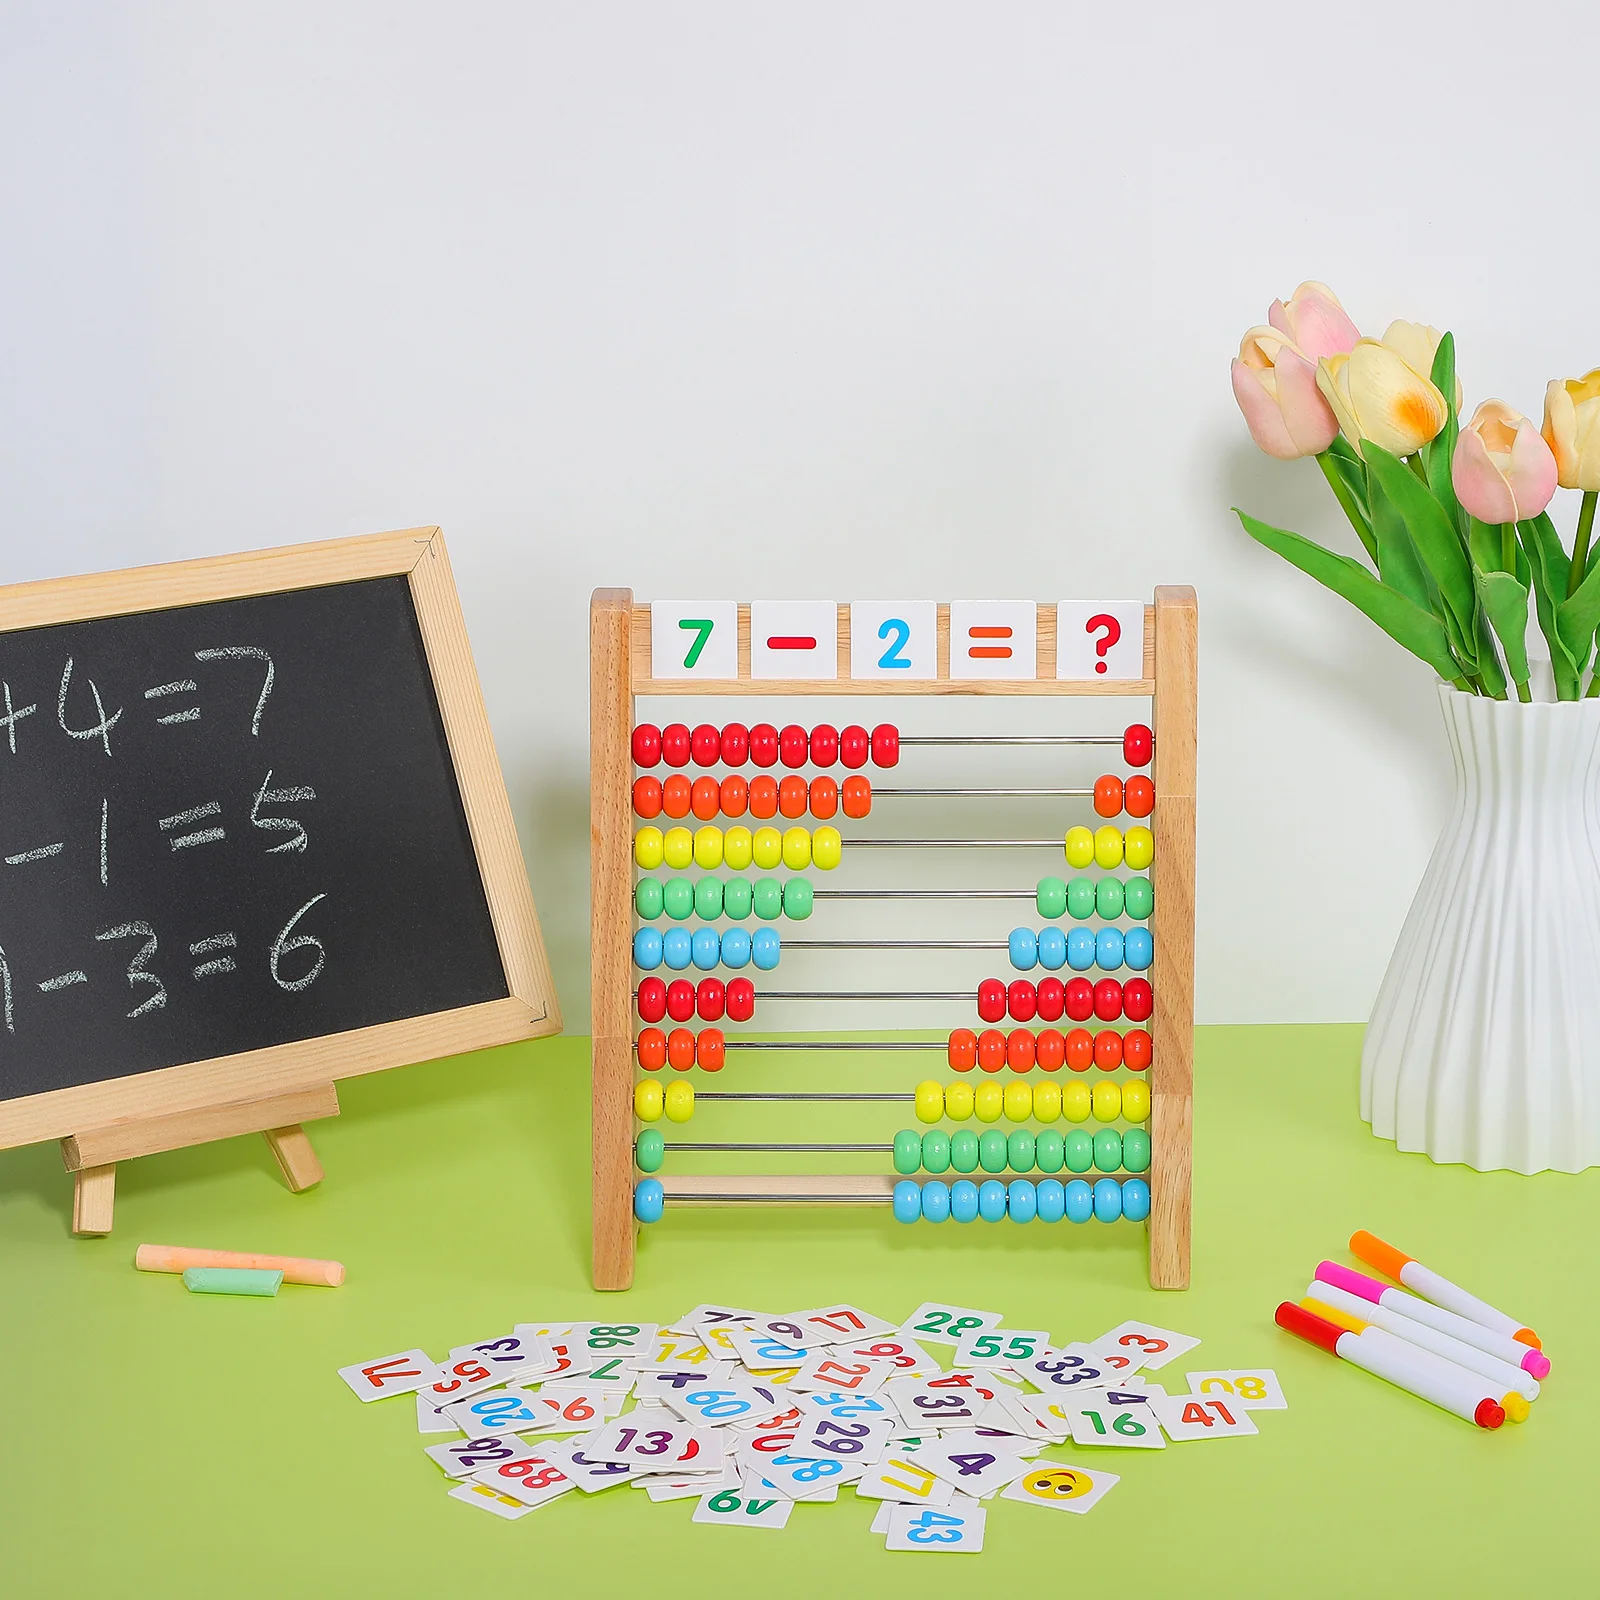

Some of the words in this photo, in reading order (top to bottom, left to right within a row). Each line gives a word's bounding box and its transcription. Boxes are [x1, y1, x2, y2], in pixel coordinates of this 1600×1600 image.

[678, 619, 714, 669] 7
[877, 618, 912, 668] 2
[1085, 613, 1122, 674] ?
[807, 1310, 867, 1333] 17
[913, 1311, 984, 1338] 28
[655, 1343, 709, 1365] 14
[969, 1335, 1037, 1360] 55
[812, 1360, 871, 1389] 27
[1035, 1355, 1101, 1385] 33
[470, 1397, 536, 1427] 20
[912, 1394, 973, 1419] 31
[1181, 1400, 1237, 1427] 41
[1080, 1410, 1147, 1436] 16
[614, 1428, 674, 1455] 13
[811, 1420, 871, 1454] 29
[947, 1452, 997, 1476] 4
[906, 1510, 966, 1544] 43
